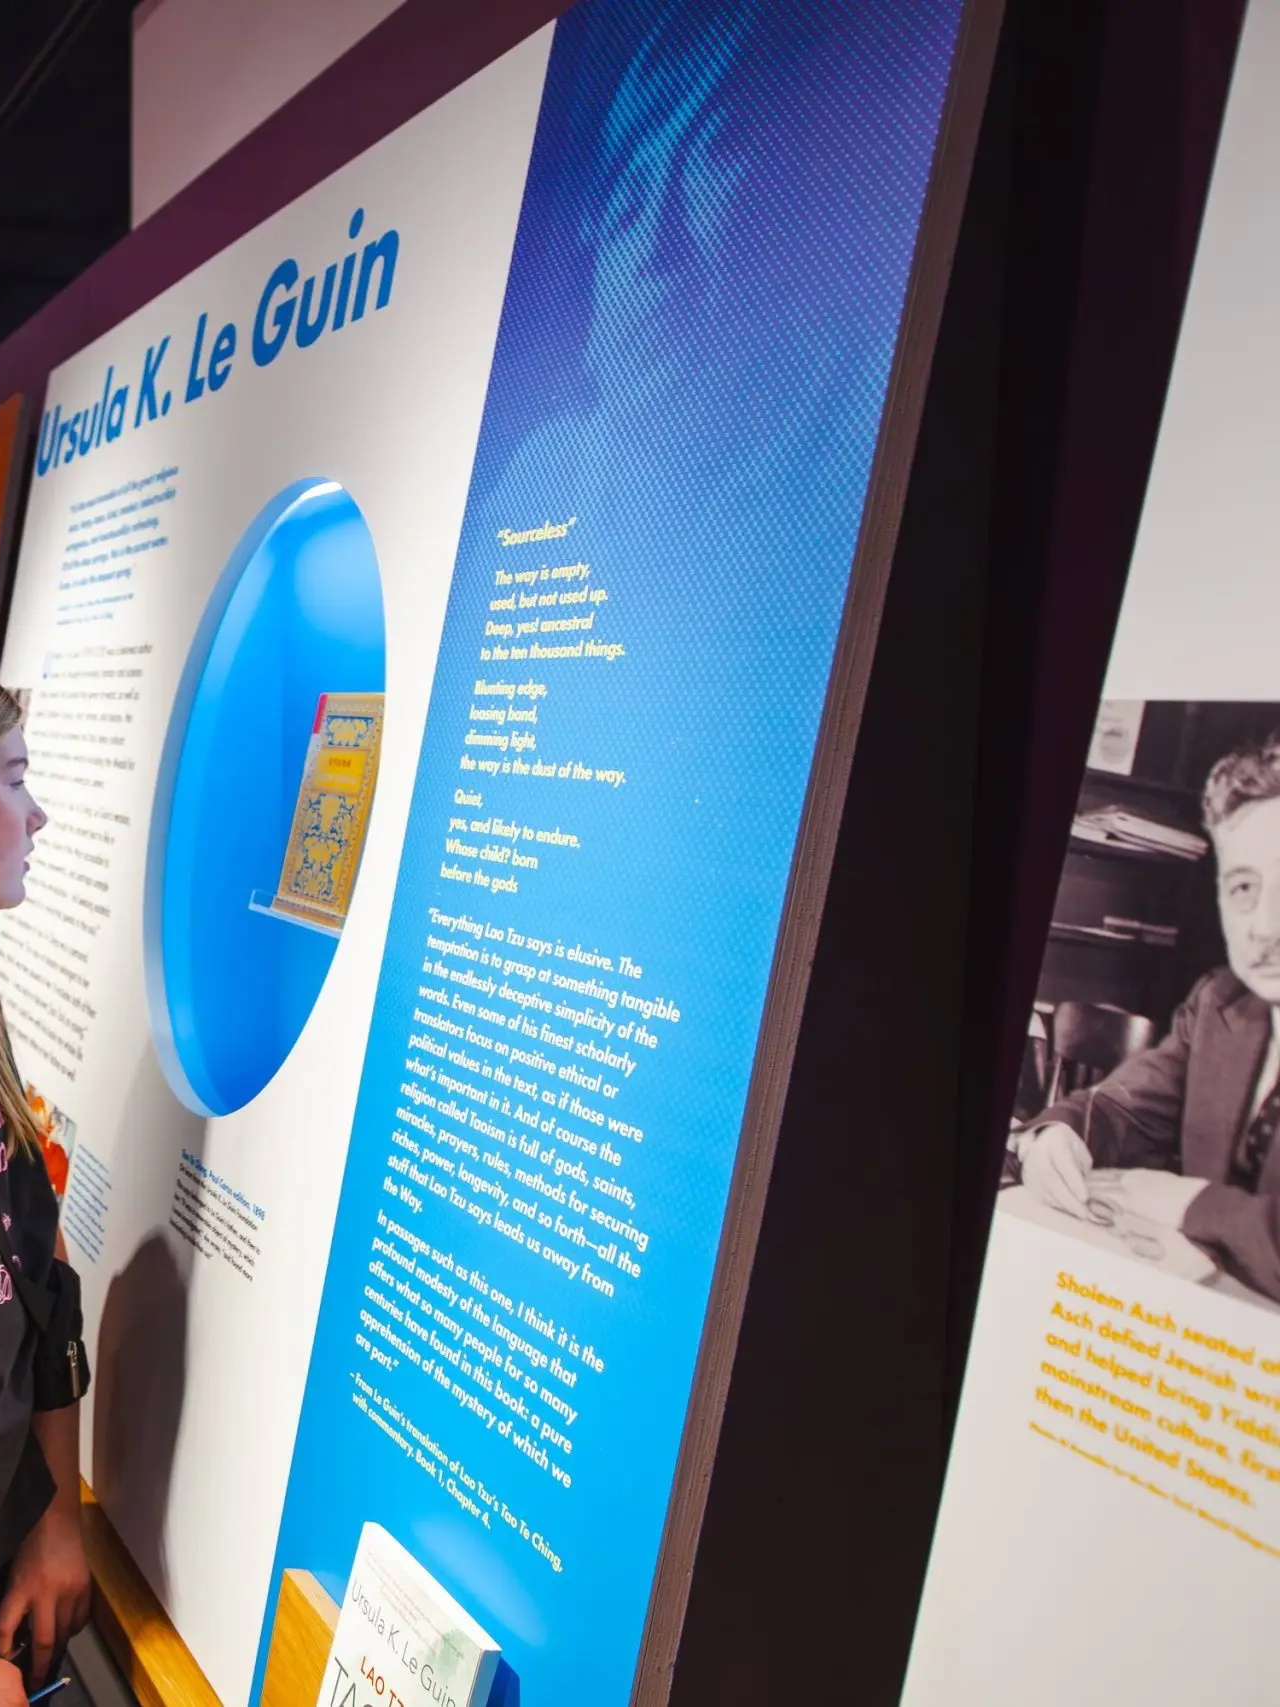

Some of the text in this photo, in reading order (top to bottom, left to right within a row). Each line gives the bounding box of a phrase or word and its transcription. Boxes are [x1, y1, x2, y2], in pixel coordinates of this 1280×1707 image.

[36, 207, 401, 477] Ursula K. Le Guin
[496, 569, 513, 585] The
[515, 571, 539, 586] way
[540, 564, 550, 580] is
[540, 612, 594, 632] ancestral
[474, 680, 516, 699] Blunting
[469, 704, 505, 725] loosing
[464, 729, 508, 751] dimming
[460, 754, 476, 770] the
[478, 760, 500, 776] way
[501, 758, 512, 774] is
[512, 758, 531, 775] the
[531, 759, 557, 777] dust
[558, 761, 573, 778] of
[572, 762, 593, 780] the
[446, 838, 538, 869] Whose child? born
[470, 818, 491, 833] and
[492, 818, 521, 843] likely
[522, 826, 535, 840] to
[440, 862, 518, 893] before the gods
[484, 922, 504, 941] Lao
[507, 928, 525, 946] Tzu
[526, 937, 553, 956] says
[554, 939, 565, 957] is
[567, 944, 613, 971] elusive.
[619, 957, 642, 979] The
[423, 956, 658, 1048] in the endlessly deceptive simplicity of the
[414, 1008, 619, 1098] translators focus on positive ethical or
[438, 1070, 488, 1104] important
[489, 1092, 500, 1110] in
[501, 1097, 511, 1116] it.
[514, 1105, 540, 1128] And
[541, 1118, 556, 1134] of
[556, 1128, 597, 1155] course
[600, 1143, 621, 1166] the
[383, 1176, 422, 1213] the Way.
[396, 1107, 649, 1252] miracles, prayers, rules, methods for securing
[387, 1156, 614, 1297] stuff that Lao Tzu says leads us away from
[377, 1209, 604, 1373] In passages such as this one, I think it is the
[356, 1333, 371, 1352] are
[369, 1261, 578, 1425] offers what so many people for so many
[1045, 1332, 1081, 1357] and
[360, 1309, 571, 1488] apprehension of the mystery of which we
[1035, 1386, 1073, 1417] then
[1079, 1407, 1108, 1434] the
[353, 1393, 368, 1412] with
[415, 1449, 436, 1477] Book
[446, 1478, 481, 1517] Chapter
[354, 1373, 373, 1397] From
[373, 1389, 383, 1405] Le
[406, 1420, 448, 1466] translation
[449, 1461, 460, 1474] of
[459, 1466, 476, 1490] Lao
[501, 1503, 517, 1528] Tao
[520, 1520, 530, 1540] Te
[351, 1577, 385, 1635] Ursula
[388, 1623, 400, 1655] K.
[401, 1641, 418, 1674] Le
[361, 1656, 385, 1695] LAO
